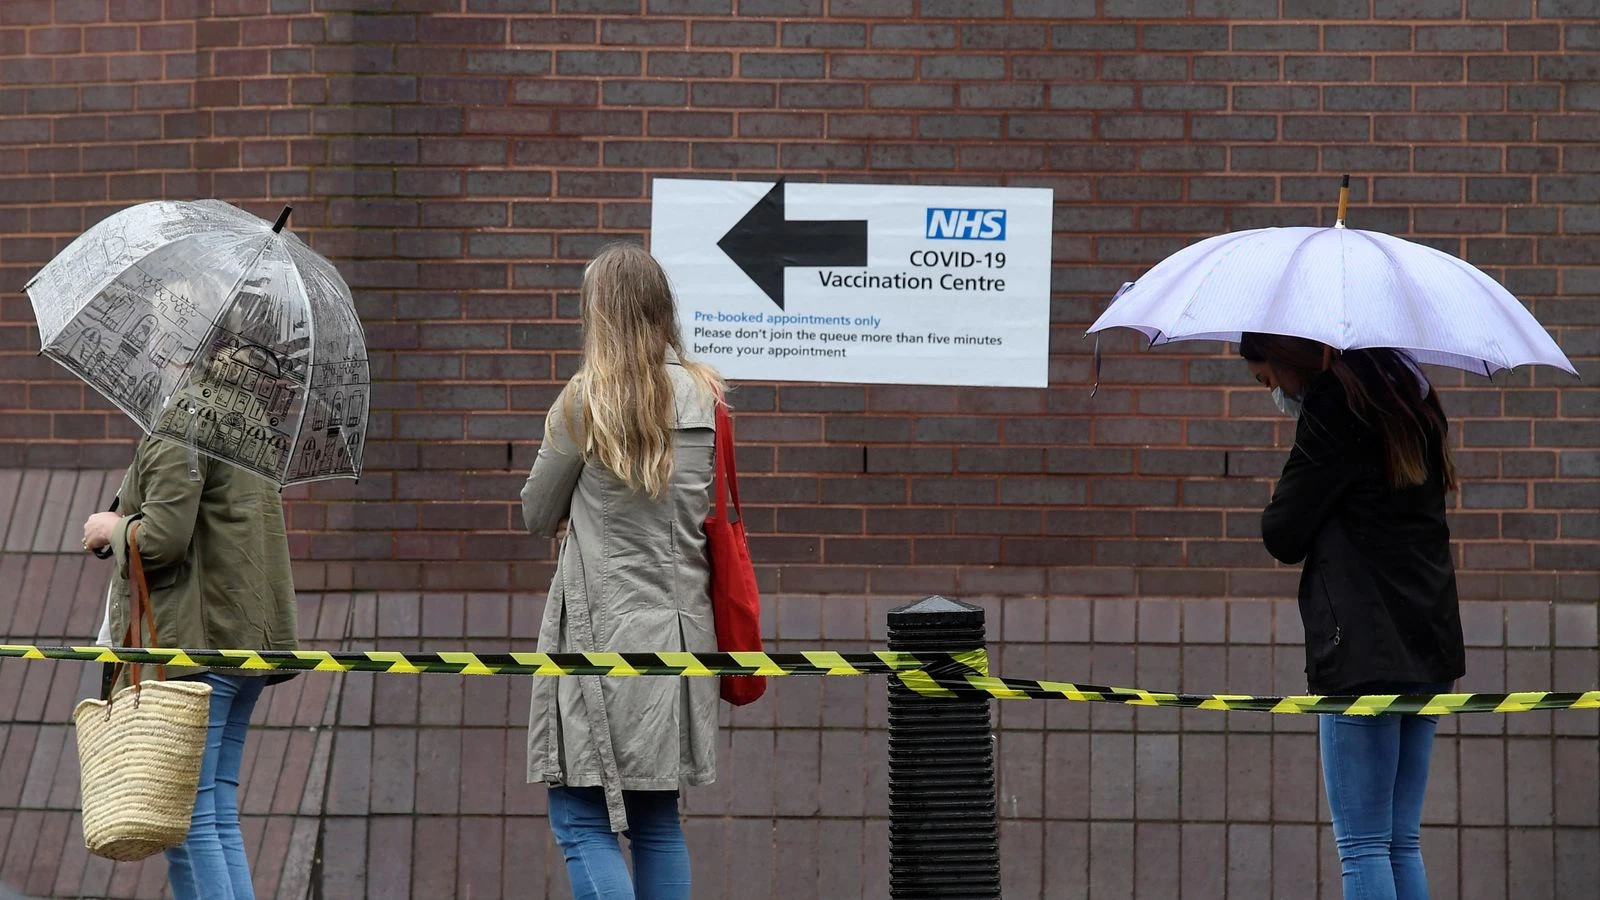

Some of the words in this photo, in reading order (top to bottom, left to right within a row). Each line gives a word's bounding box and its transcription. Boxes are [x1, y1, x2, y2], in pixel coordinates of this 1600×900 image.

[927, 209, 1004, 239] NHS
[909, 250, 1007, 269] COVID-19
[818, 270, 933, 290] Vaccination
[939, 273, 1006, 292] Centre
[694, 311, 763, 323] Pre-booked
[766, 313, 851, 326] appointments
[854, 315, 881, 329] only
[694, 327, 732, 338] Please
[735, 328, 767, 339] don't
[769, 329, 793, 342] join
[796, 330, 816, 341] the
[819, 331, 858, 343] queue
[861, 332, 893, 344] more
[896, 332, 924, 344] than
[927, 333, 951, 345] five
[953, 334, 1003, 346] minutes
[693, 343, 733, 355] before
[736, 346, 765, 358] your
[768, 345, 846, 358] appointment
